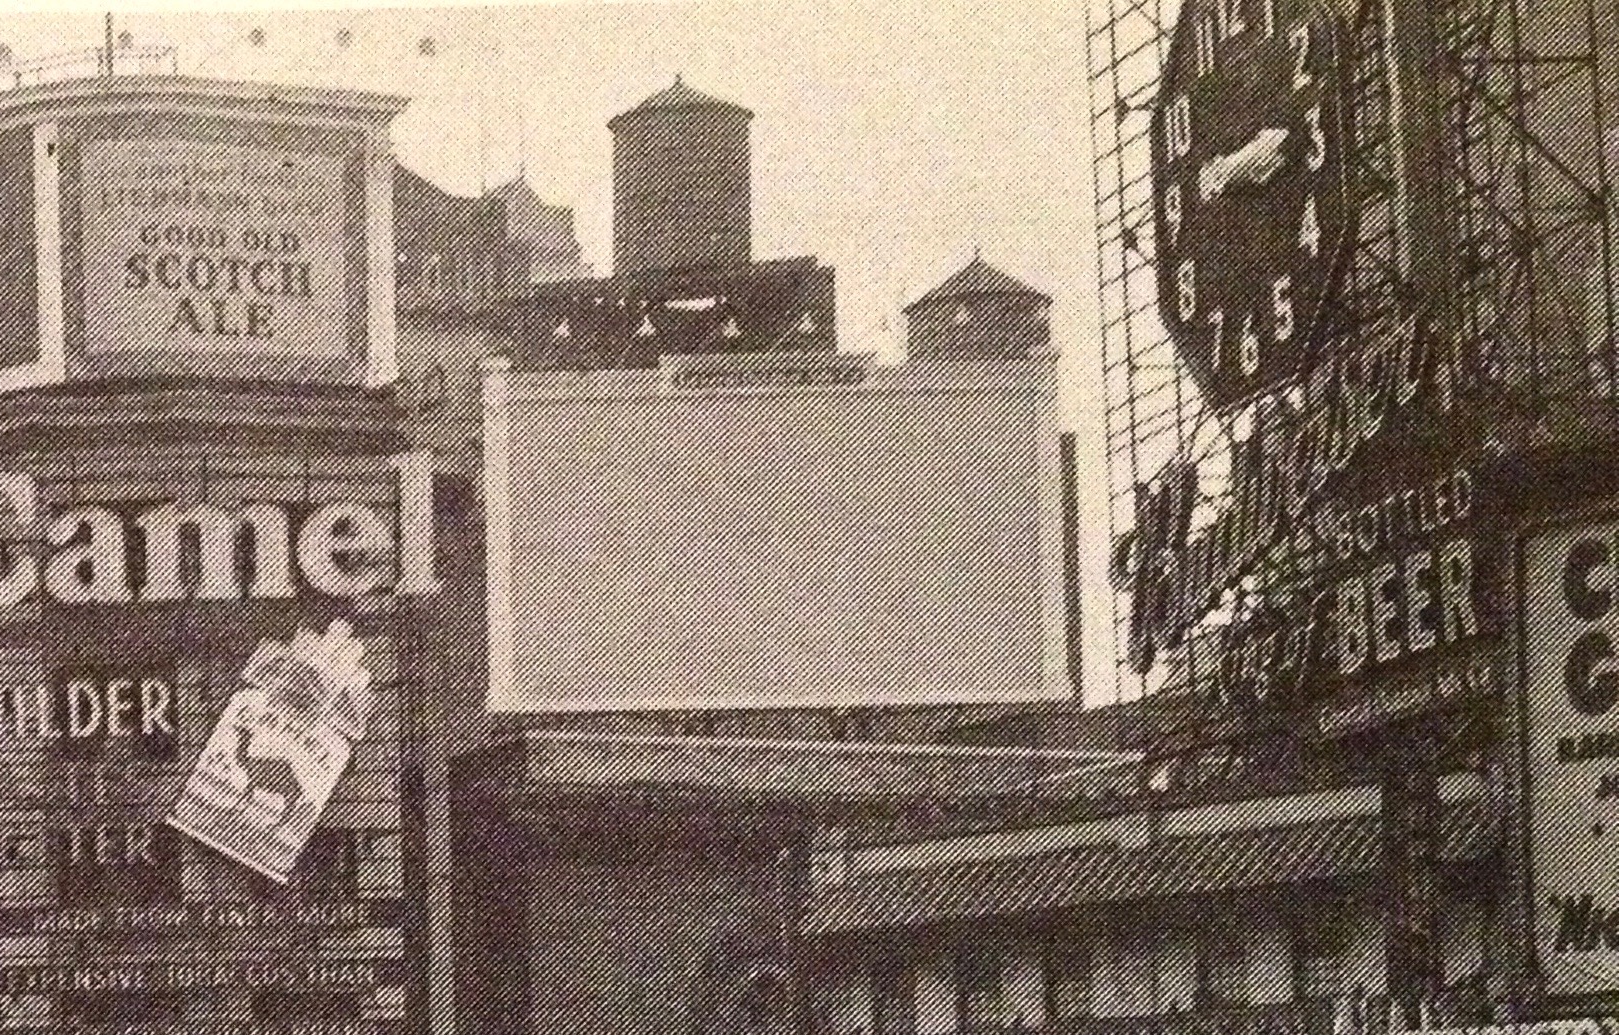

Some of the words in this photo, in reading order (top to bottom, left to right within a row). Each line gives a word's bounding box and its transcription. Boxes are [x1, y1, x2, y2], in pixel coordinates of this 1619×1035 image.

[1288, 21, 1313, 91] 2
[1302, 101, 1328, 174] 3
[140, 224, 227, 249] GOOD
[242, 228, 300, 253] OLD
[1162, 181, 1184, 251] 9
[1296, 191, 1322, 260] 4
[124, 251, 313, 298] SCOTCH
[1174, 256, 1198, 324] 8
[1270, 271, 1296, 345] 5
[170, 297, 276, 339] ALE
[1205, 305, 1227, 375] 7
[1238, 309, 1261, 378] 6
[1335, 467, 1476, 561] BOTTLED
[1335, 536, 1478, 676] BEER
[304, 963, 377, 986] THAN
